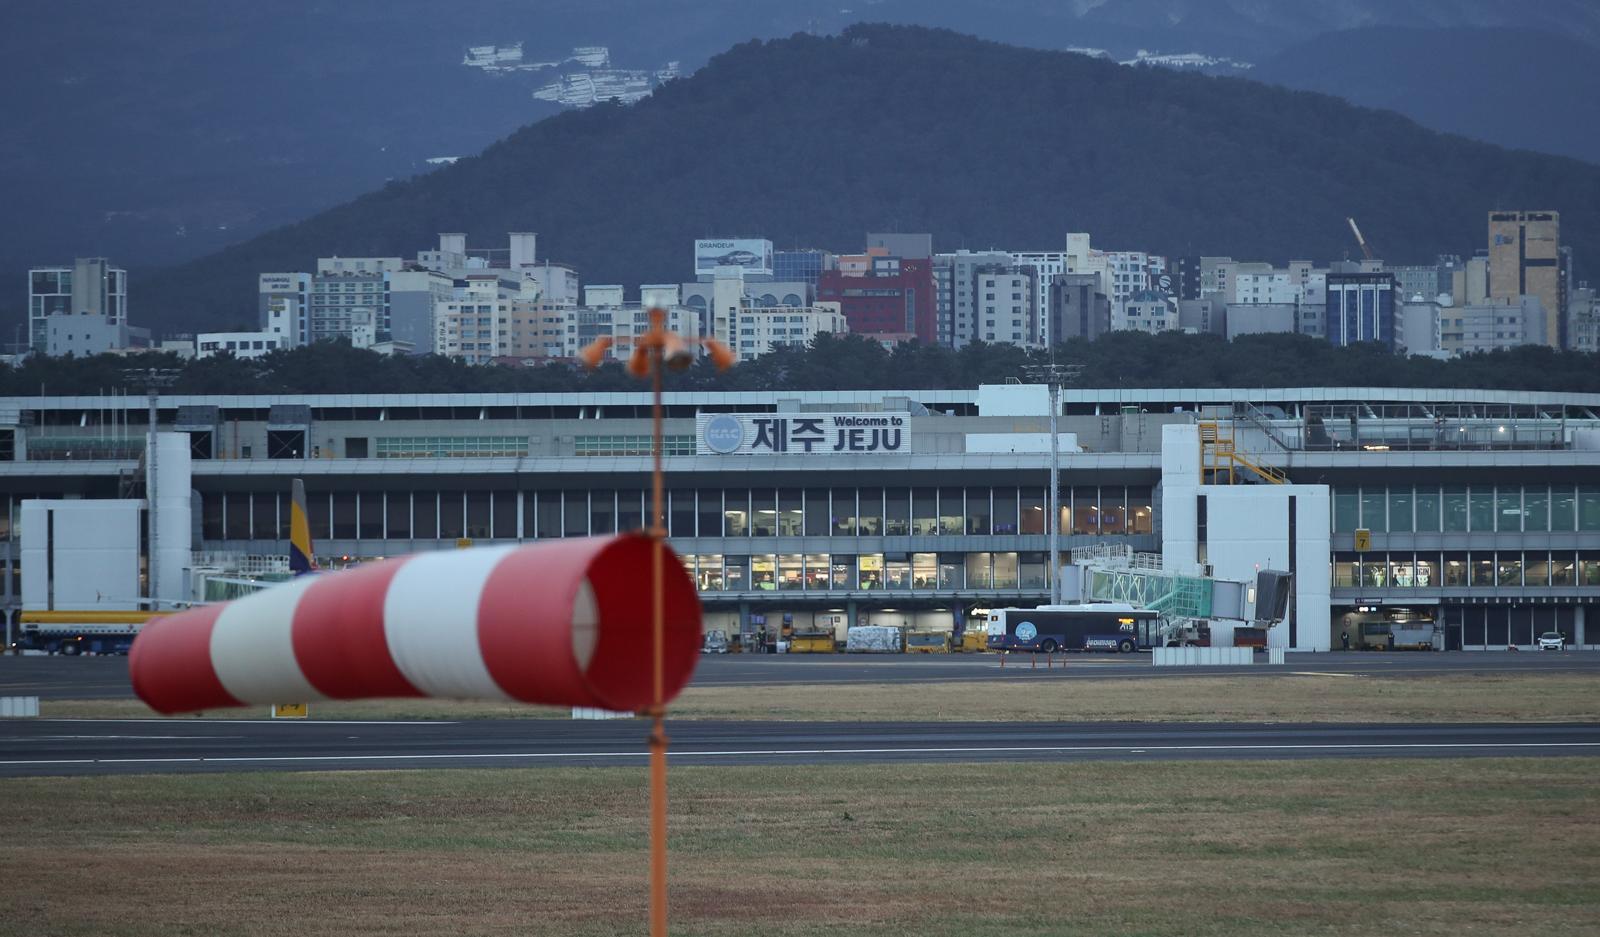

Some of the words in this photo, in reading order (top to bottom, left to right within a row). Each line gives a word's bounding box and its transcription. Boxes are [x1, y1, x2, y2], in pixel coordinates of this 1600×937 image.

[834, 416, 889, 426] Welcome
[891, 416, 903, 426] to
[751, 418, 825, 452] 제주
[833, 429, 901, 451] JEJU
